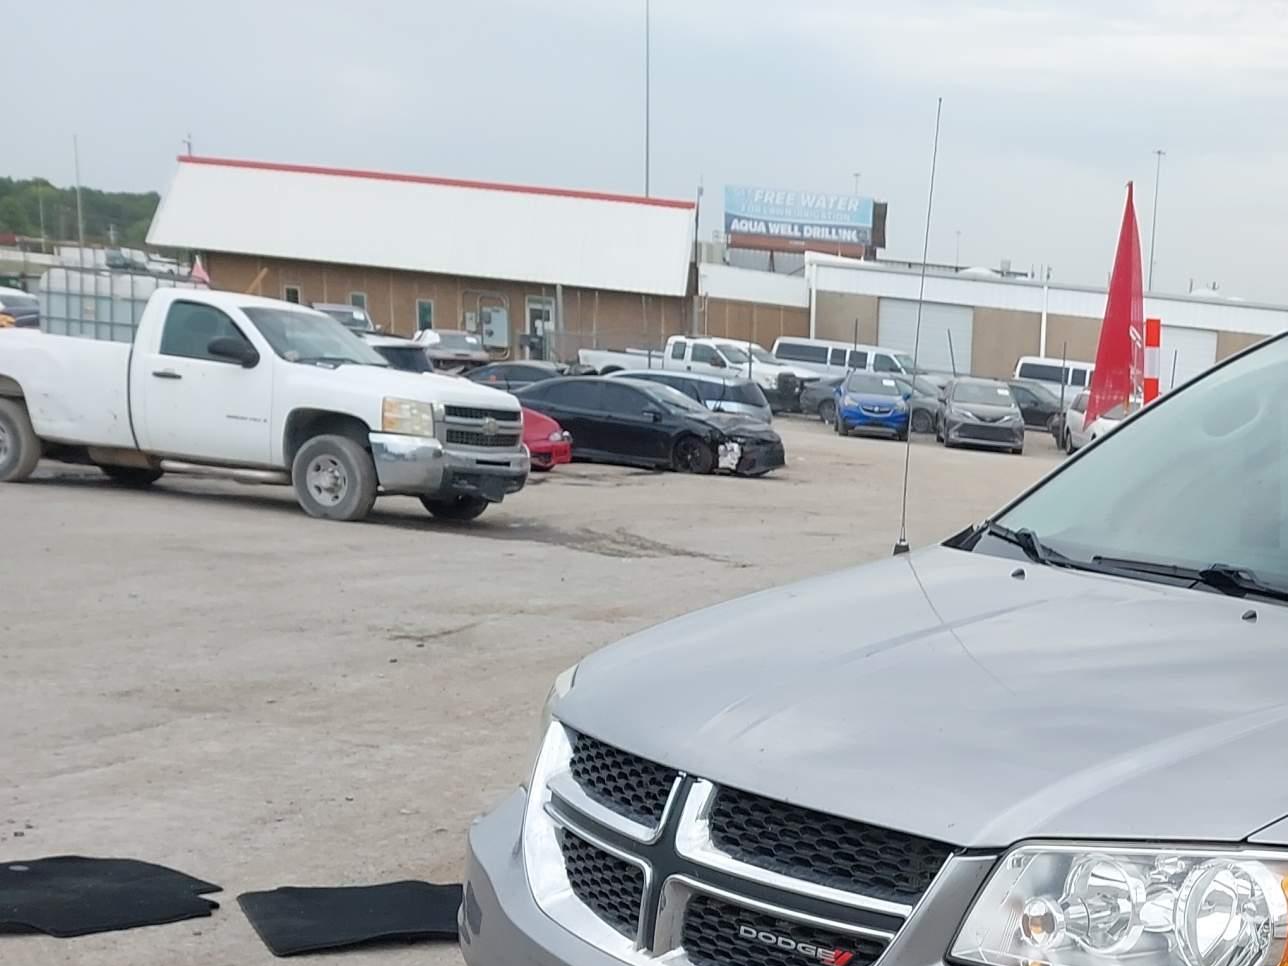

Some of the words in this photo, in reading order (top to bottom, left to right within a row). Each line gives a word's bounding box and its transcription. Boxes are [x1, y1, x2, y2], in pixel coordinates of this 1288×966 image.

[754, 190, 795, 207] FREE
[801, 192, 860, 212] WATER
[730, 218, 767, 233] AQUA
[768, 221, 800, 237] WELL
[738, 925, 836, 962] DODGE
